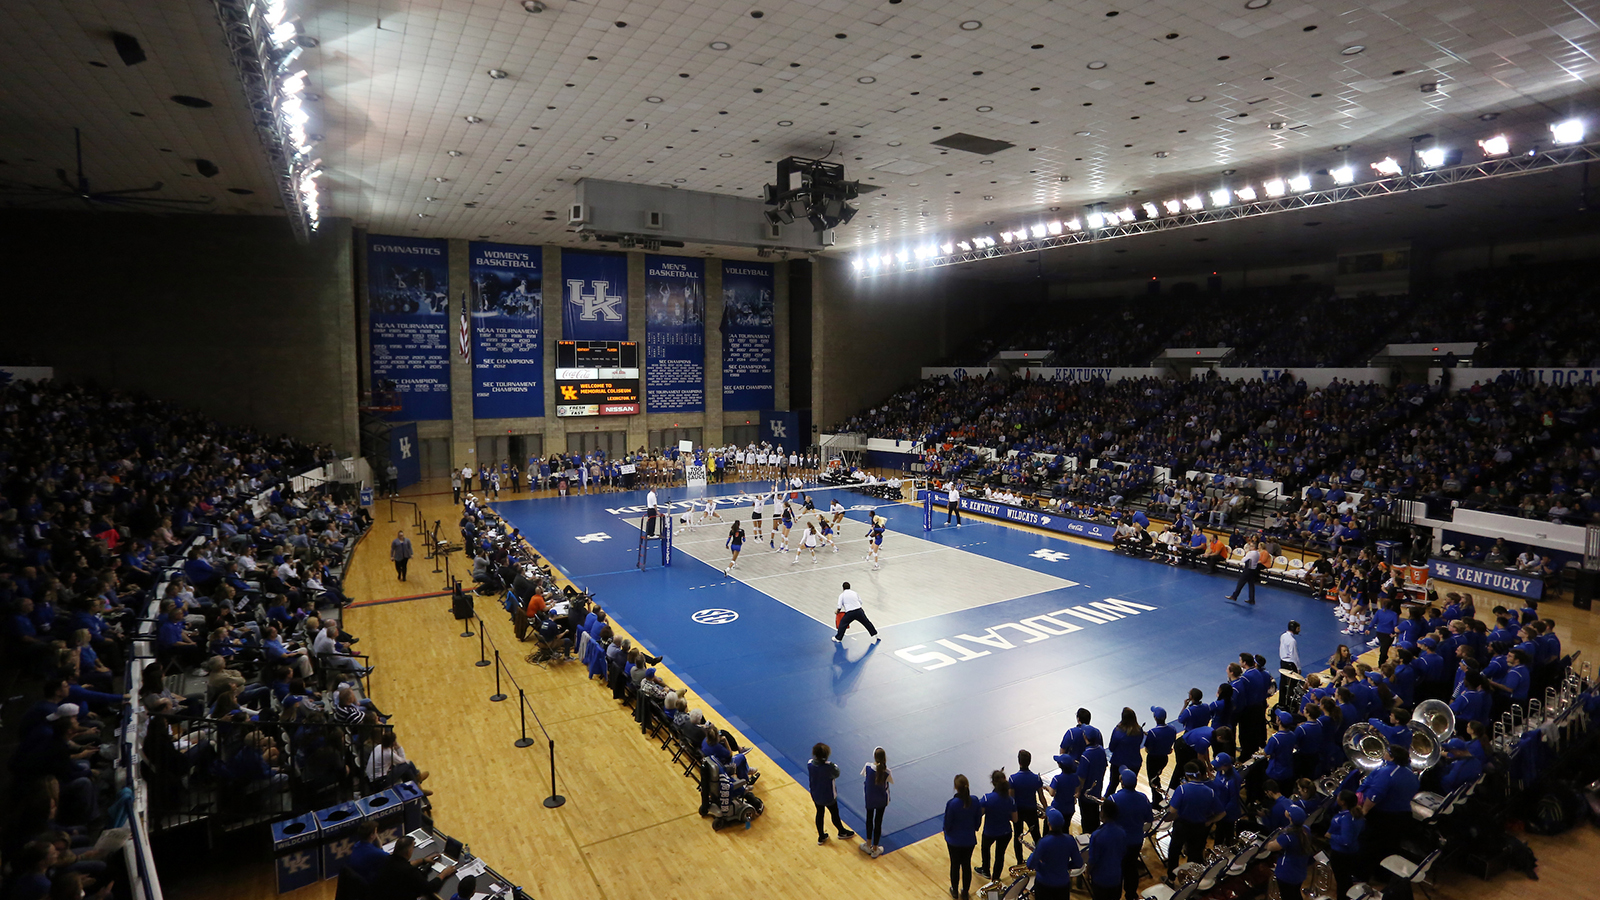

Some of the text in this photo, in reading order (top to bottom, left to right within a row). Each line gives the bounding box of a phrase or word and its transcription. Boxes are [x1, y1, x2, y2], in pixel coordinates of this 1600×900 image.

[373, 244, 440, 256] GYMNASTICS
[484, 250, 528, 260] WOMEN'S
[476, 258, 536, 268] BASKETBALL
[650, 269, 698, 278] BASKETBALL
[725, 267, 769, 276] VOLLEYBALL
[567, 279, 622, 321] UK
[560, 386, 579, 400] UK
[770, 420, 787, 438] UK
[399, 436, 411, 459] UK
[969, 501, 1000, 515] KENTUCKY
[1006, 508, 1038, 524] WILDCATS
[1435, 563, 1531, 593] UK KENTUCKY
[894, 598, 1158, 671] WILDCATS
[368, 806, 402, 821] WILDCATS
[326, 819, 359, 833] KENTUCKY
[277, 834, 316, 849] WILDCATS
[282, 851, 310, 874] UK
